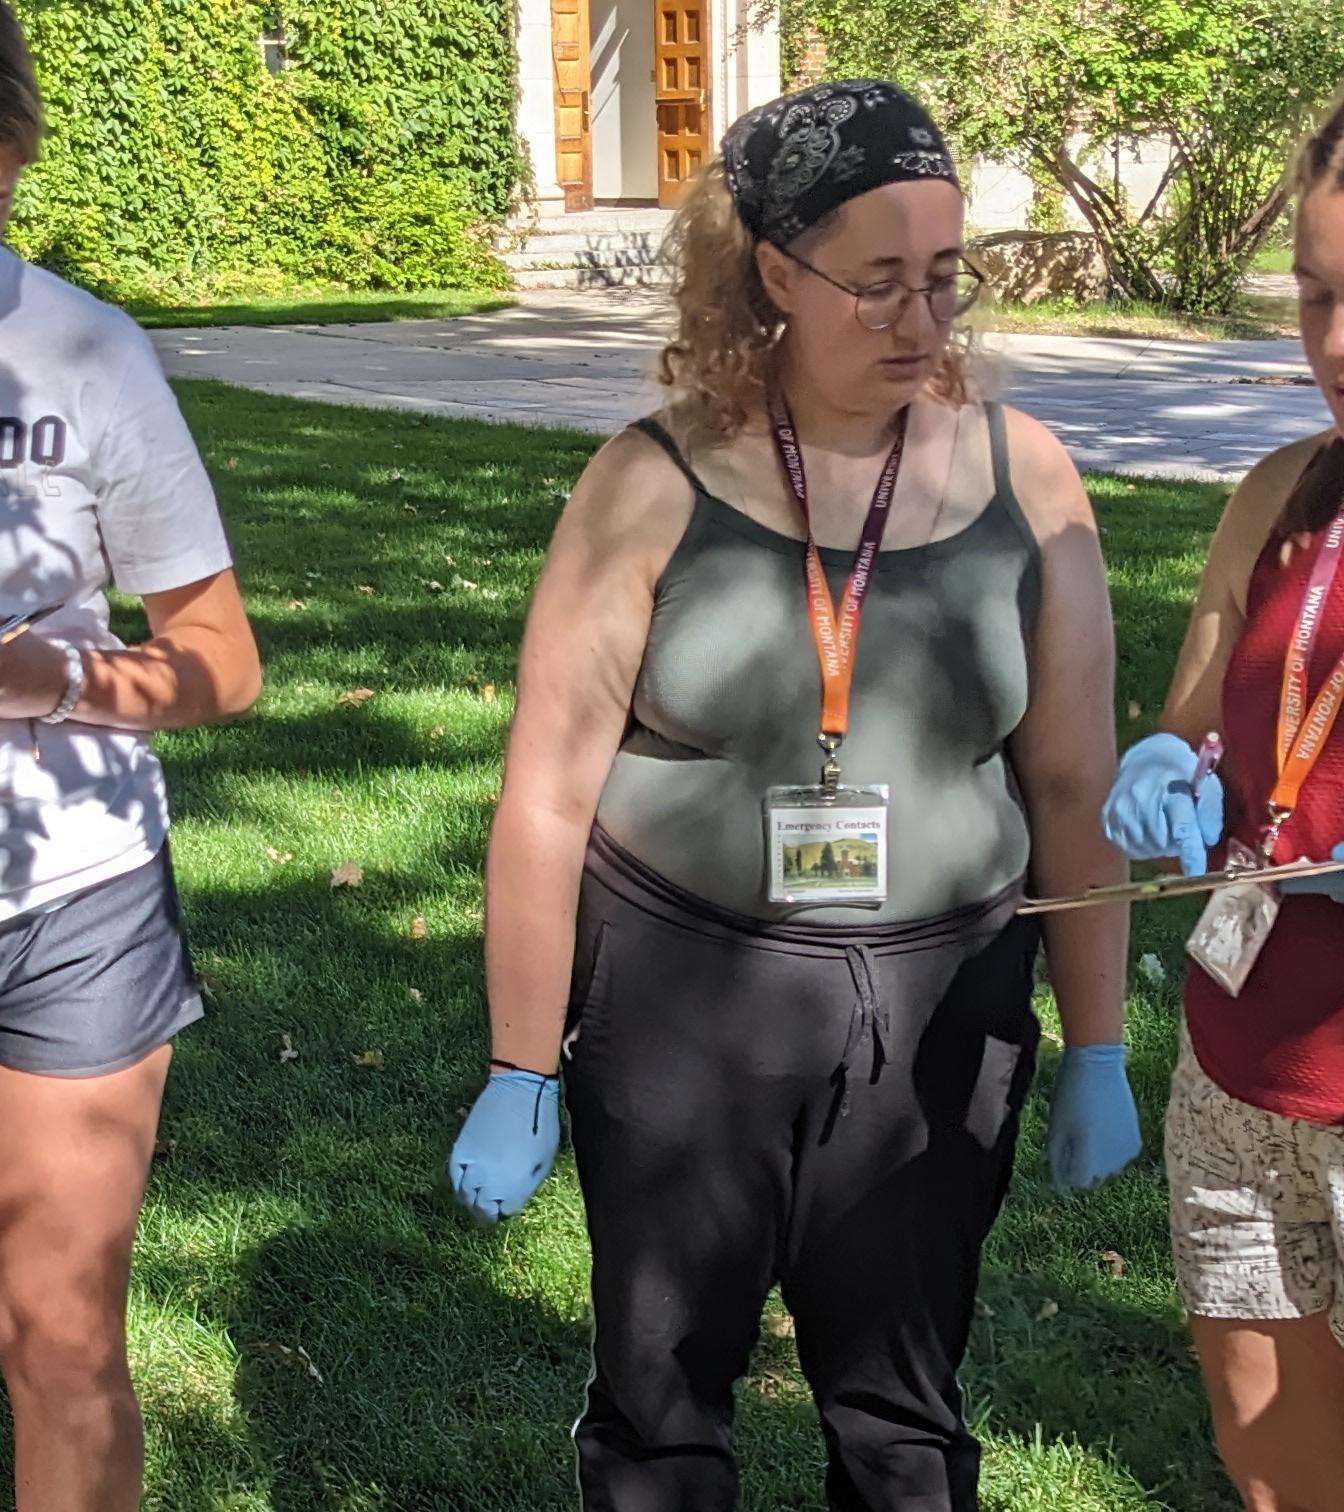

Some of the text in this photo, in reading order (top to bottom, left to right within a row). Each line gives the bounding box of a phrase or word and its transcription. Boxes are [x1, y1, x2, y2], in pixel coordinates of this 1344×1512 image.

[850, 541, 877, 597] MONTANA
[814, 598, 828, 613] OF
[1295, 585, 1325, 651] MONTANA
[817, 616, 841, 677] MONTANA
[1330, 673, 1344, 693] OF
[1296, 690, 1336, 760] MONTANA
[777, 820, 881, 832] Emergency Contacts
